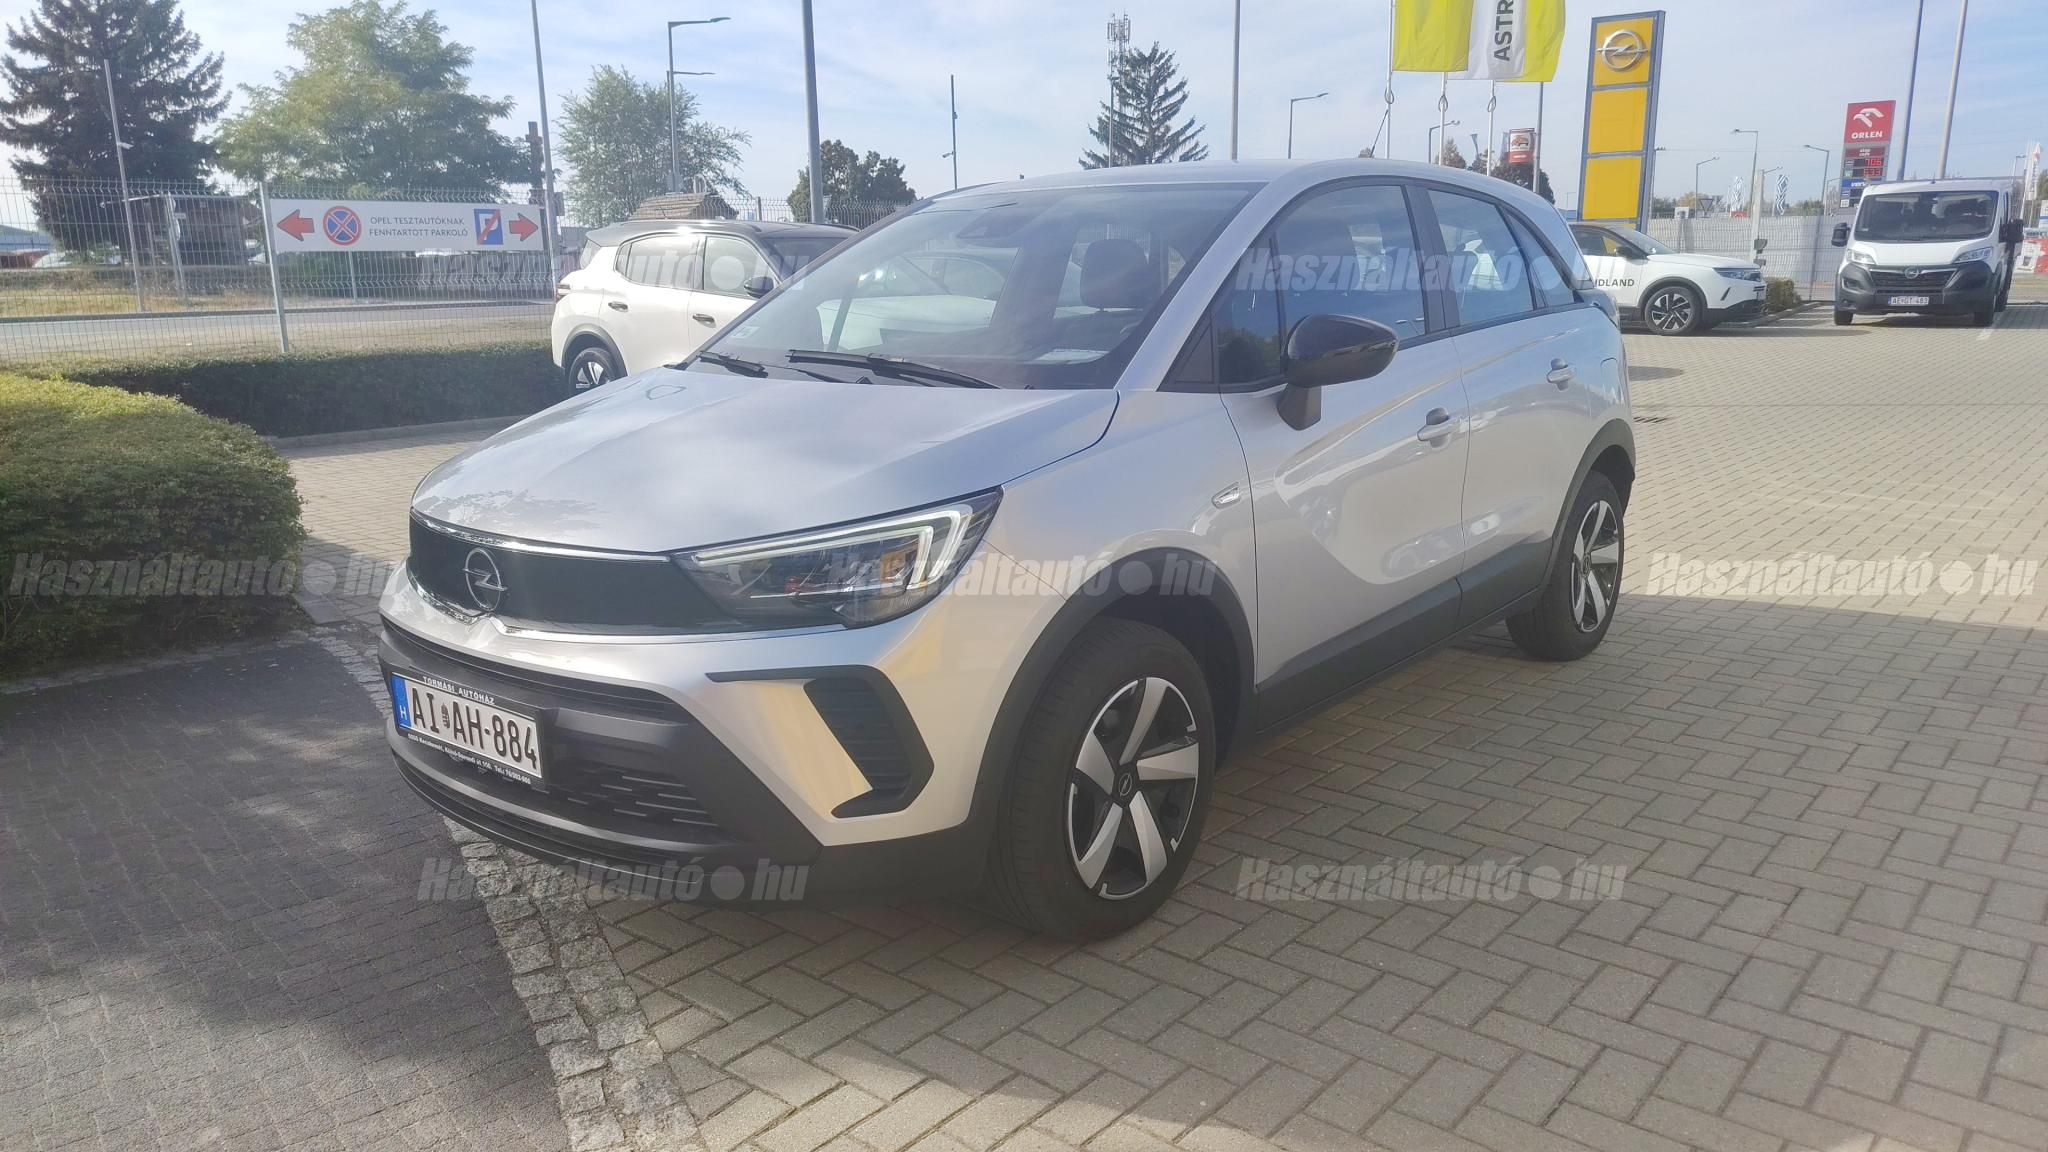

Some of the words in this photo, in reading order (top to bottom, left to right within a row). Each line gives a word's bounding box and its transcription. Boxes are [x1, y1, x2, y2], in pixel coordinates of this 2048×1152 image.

[1493, 0, 1514, 61] ASTR
[1851, 130, 1883, 140] ORLEN
[370, 216, 393, 225] OPEL
[394, 215, 465, 226] TESZTAUTÓKNAK
[369, 228, 429, 237] FENNTARTOTT
[431, 227, 469, 237] PARKOLÓ
[400, 705, 407, 721] H
